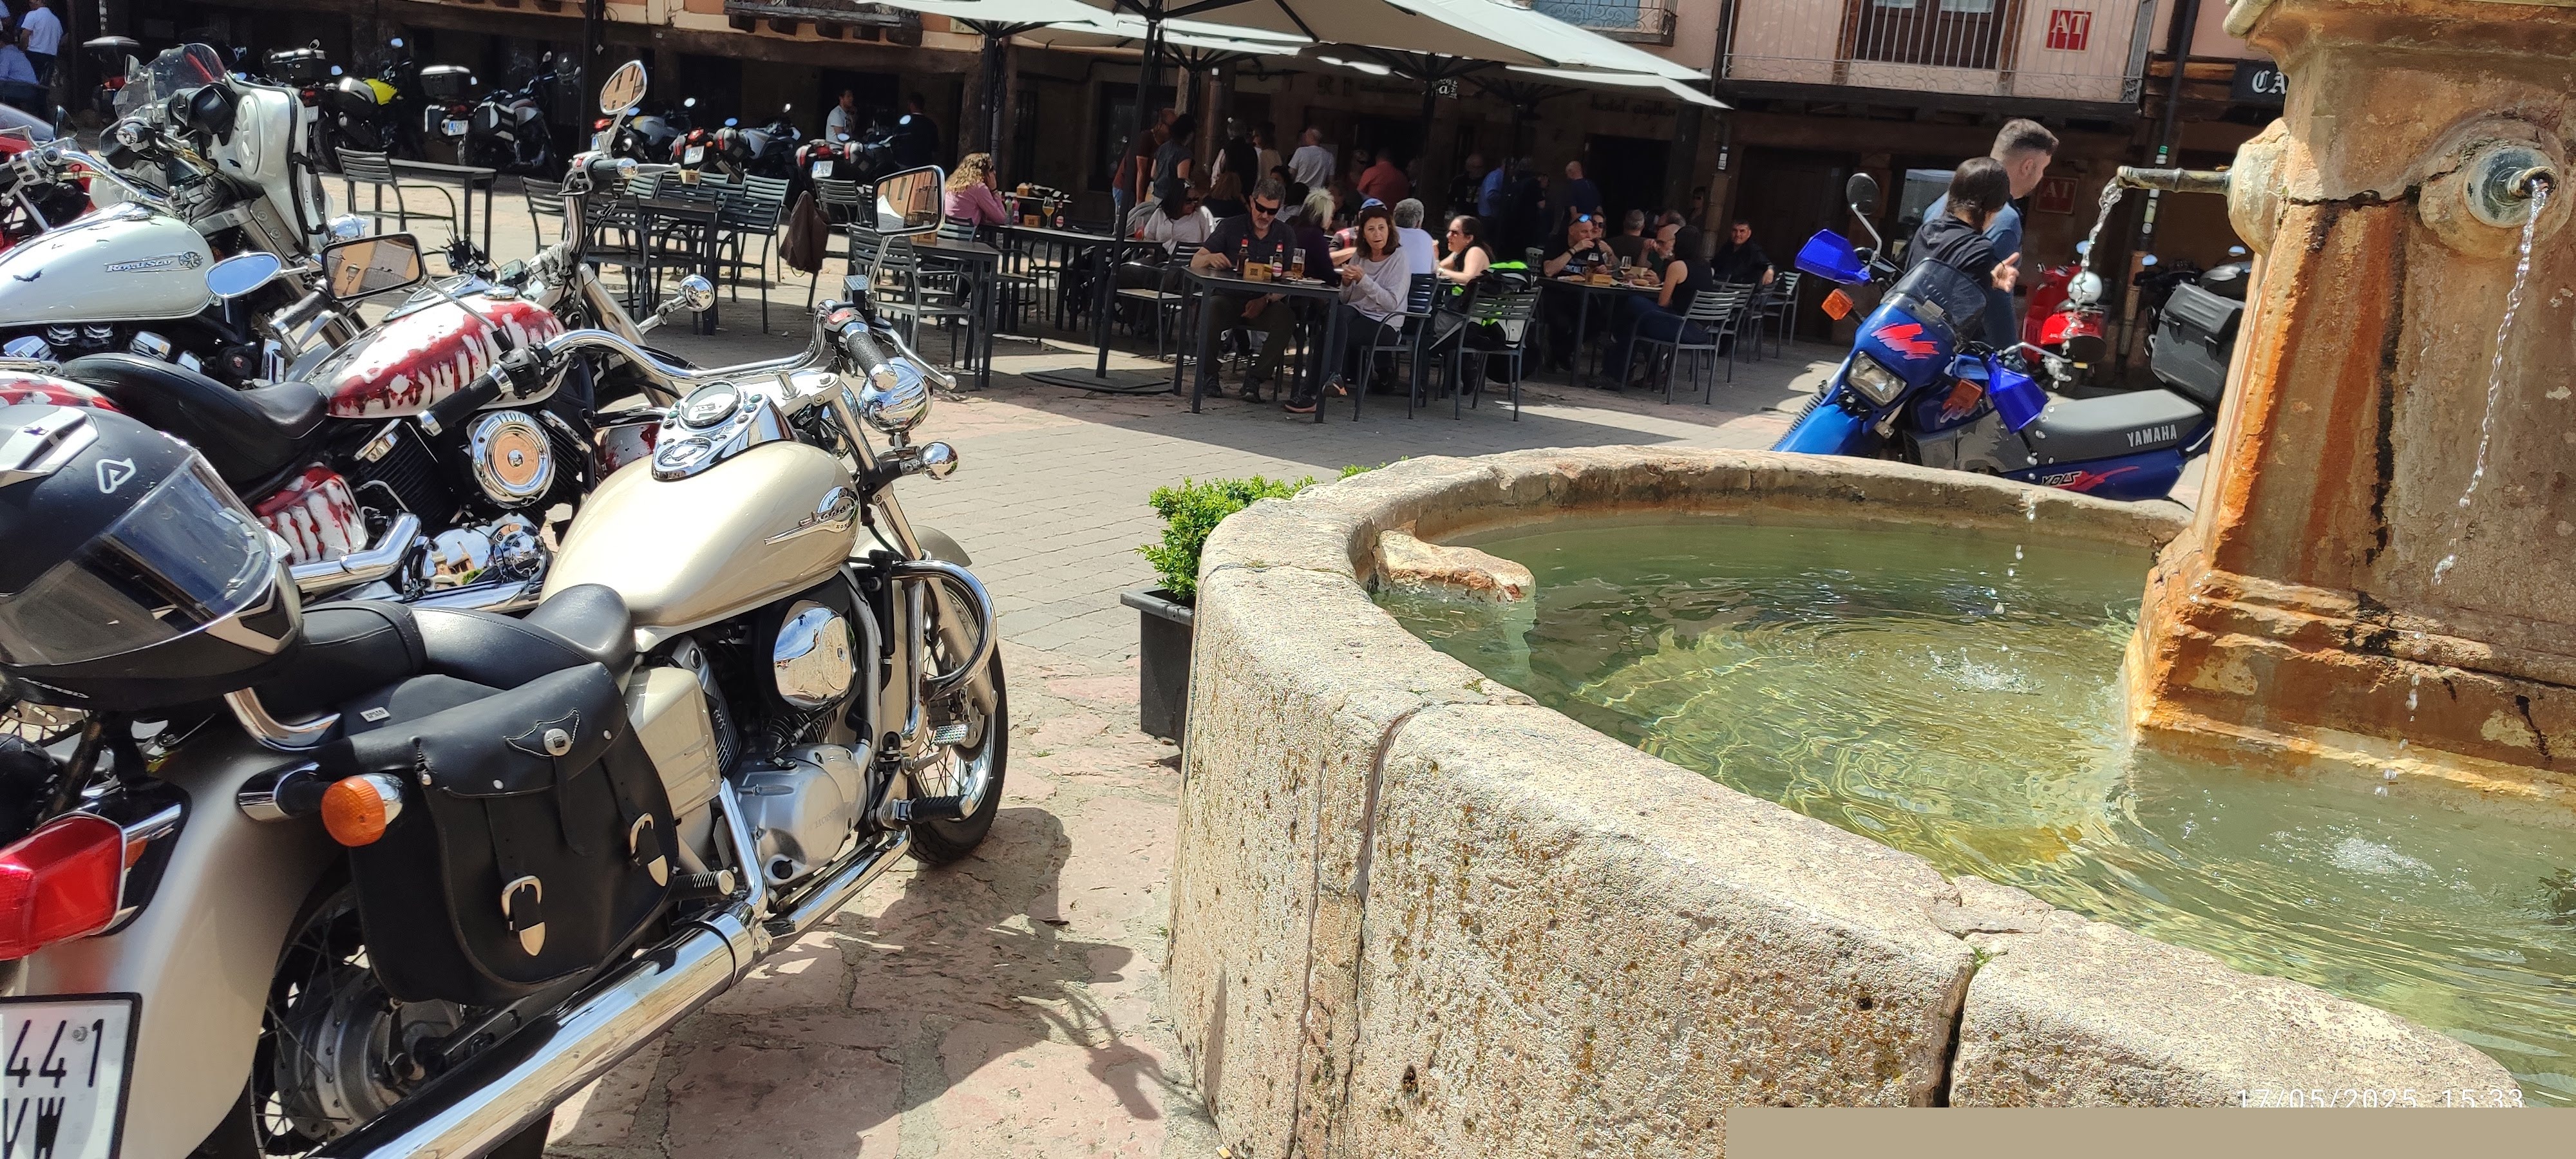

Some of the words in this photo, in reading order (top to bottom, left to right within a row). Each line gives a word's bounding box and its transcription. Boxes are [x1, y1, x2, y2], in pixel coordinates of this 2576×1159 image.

[2050, 13, 2090, 34] AT
[2041, 181, 2074, 198] AT
[496, 412, 526, 424] 1100
[2126, 424, 2177, 448] YAMAHA
[5, 1019, 104, 1088] 441
